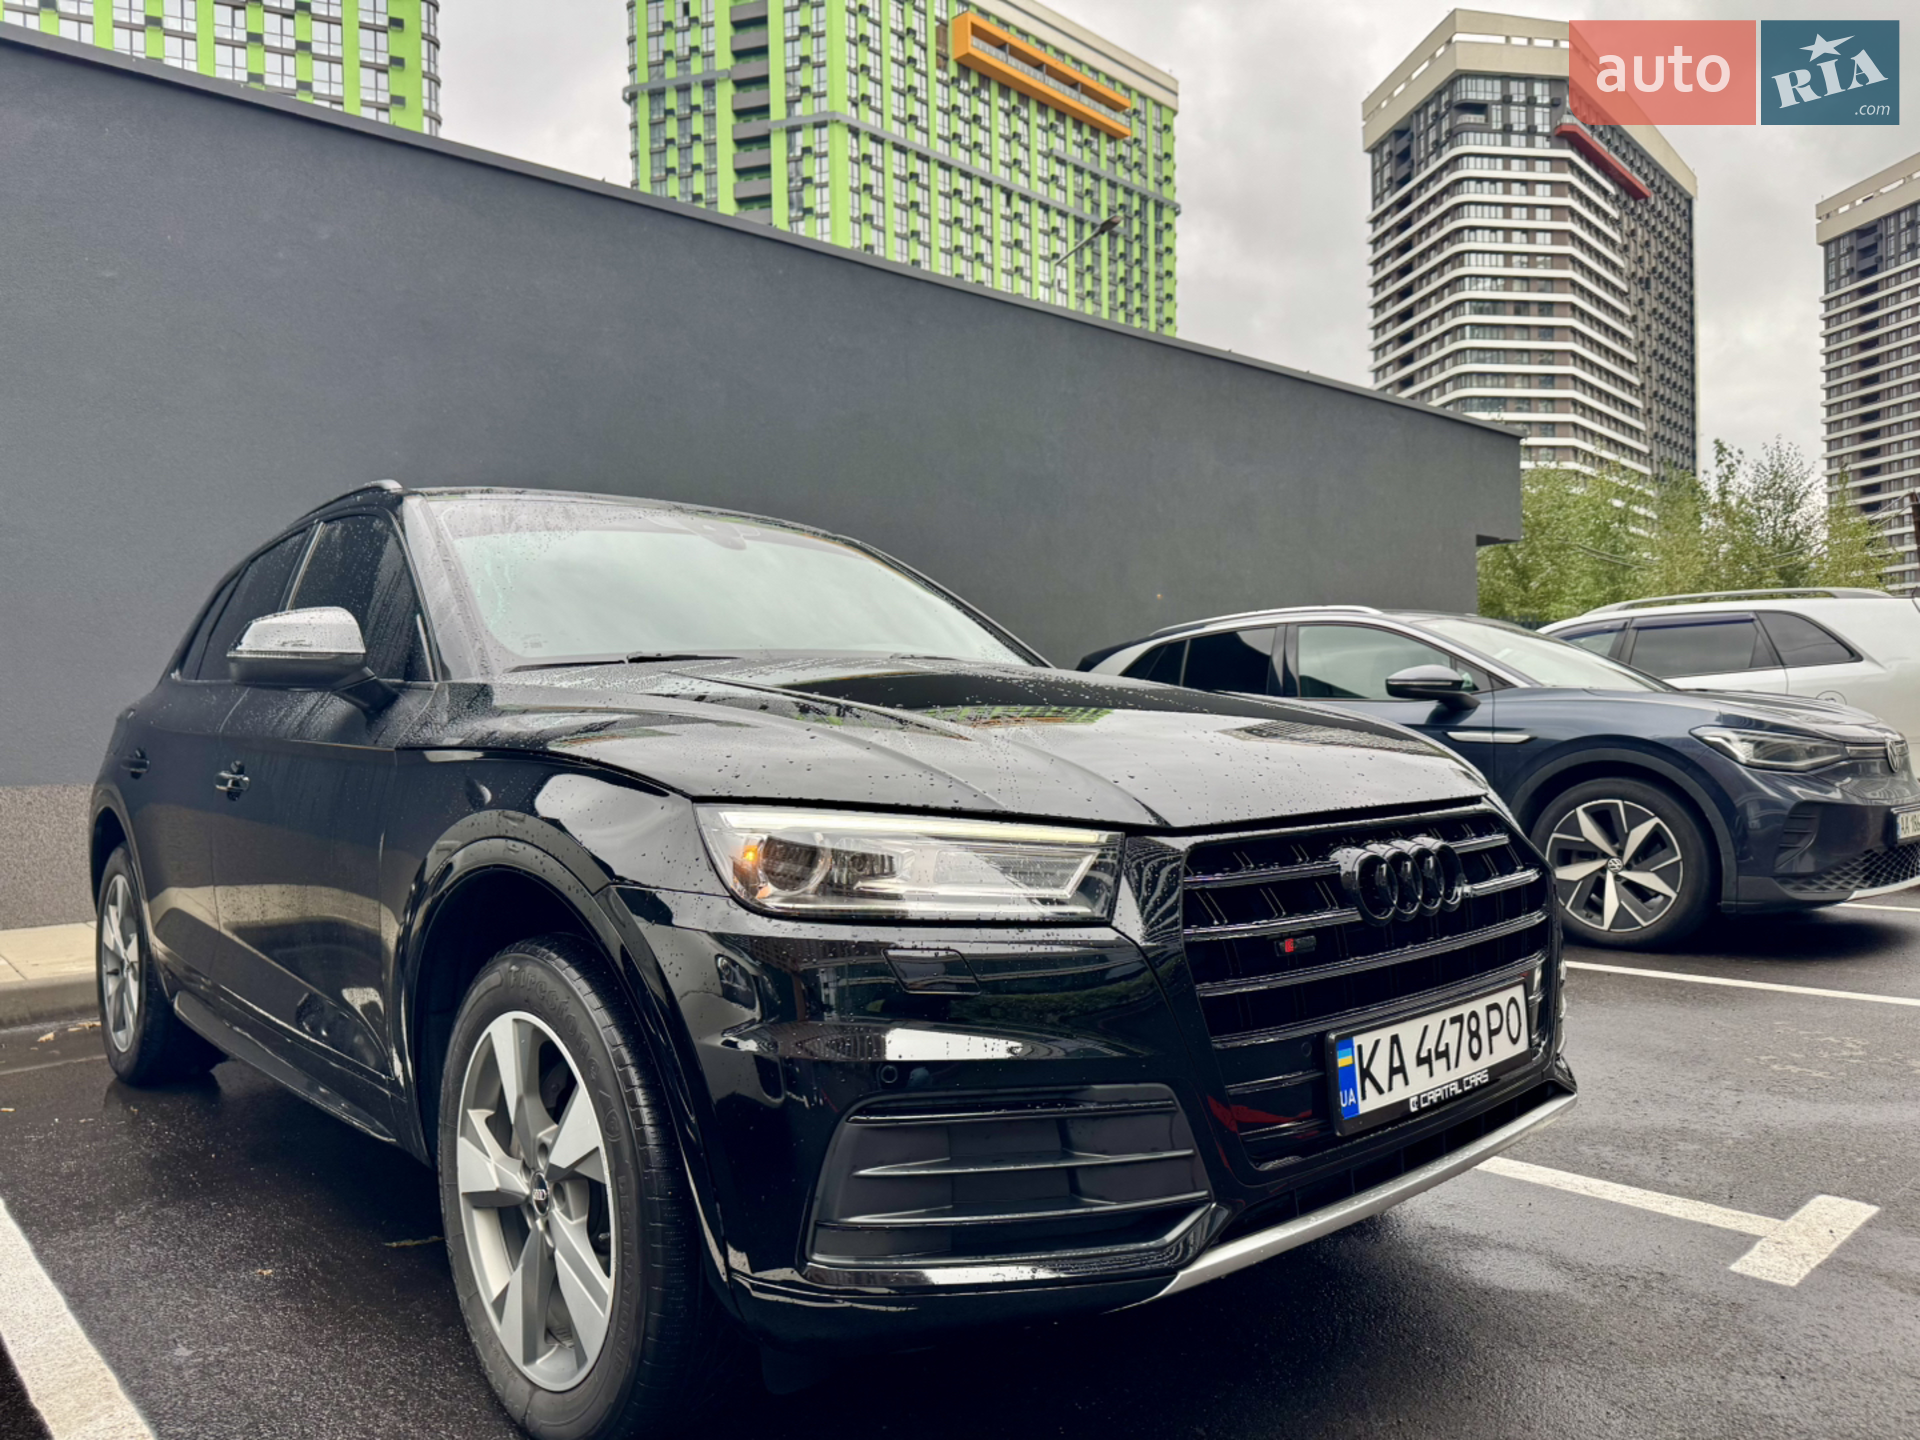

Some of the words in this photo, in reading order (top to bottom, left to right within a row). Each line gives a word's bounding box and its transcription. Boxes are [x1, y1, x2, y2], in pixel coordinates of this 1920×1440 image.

[508, 964, 599, 1081] Firestone
[1356, 1032, 1410, 1101] KA
[1415, 1010, 1483, 1079] 4478
[1485, 995, 1522, 1056] PO
[1339, 1086, 1357, 1107] UA
[1420, 1081, 1463, 1108] CAPITAL
[1463, 1068, 1489, 1091] CARS
